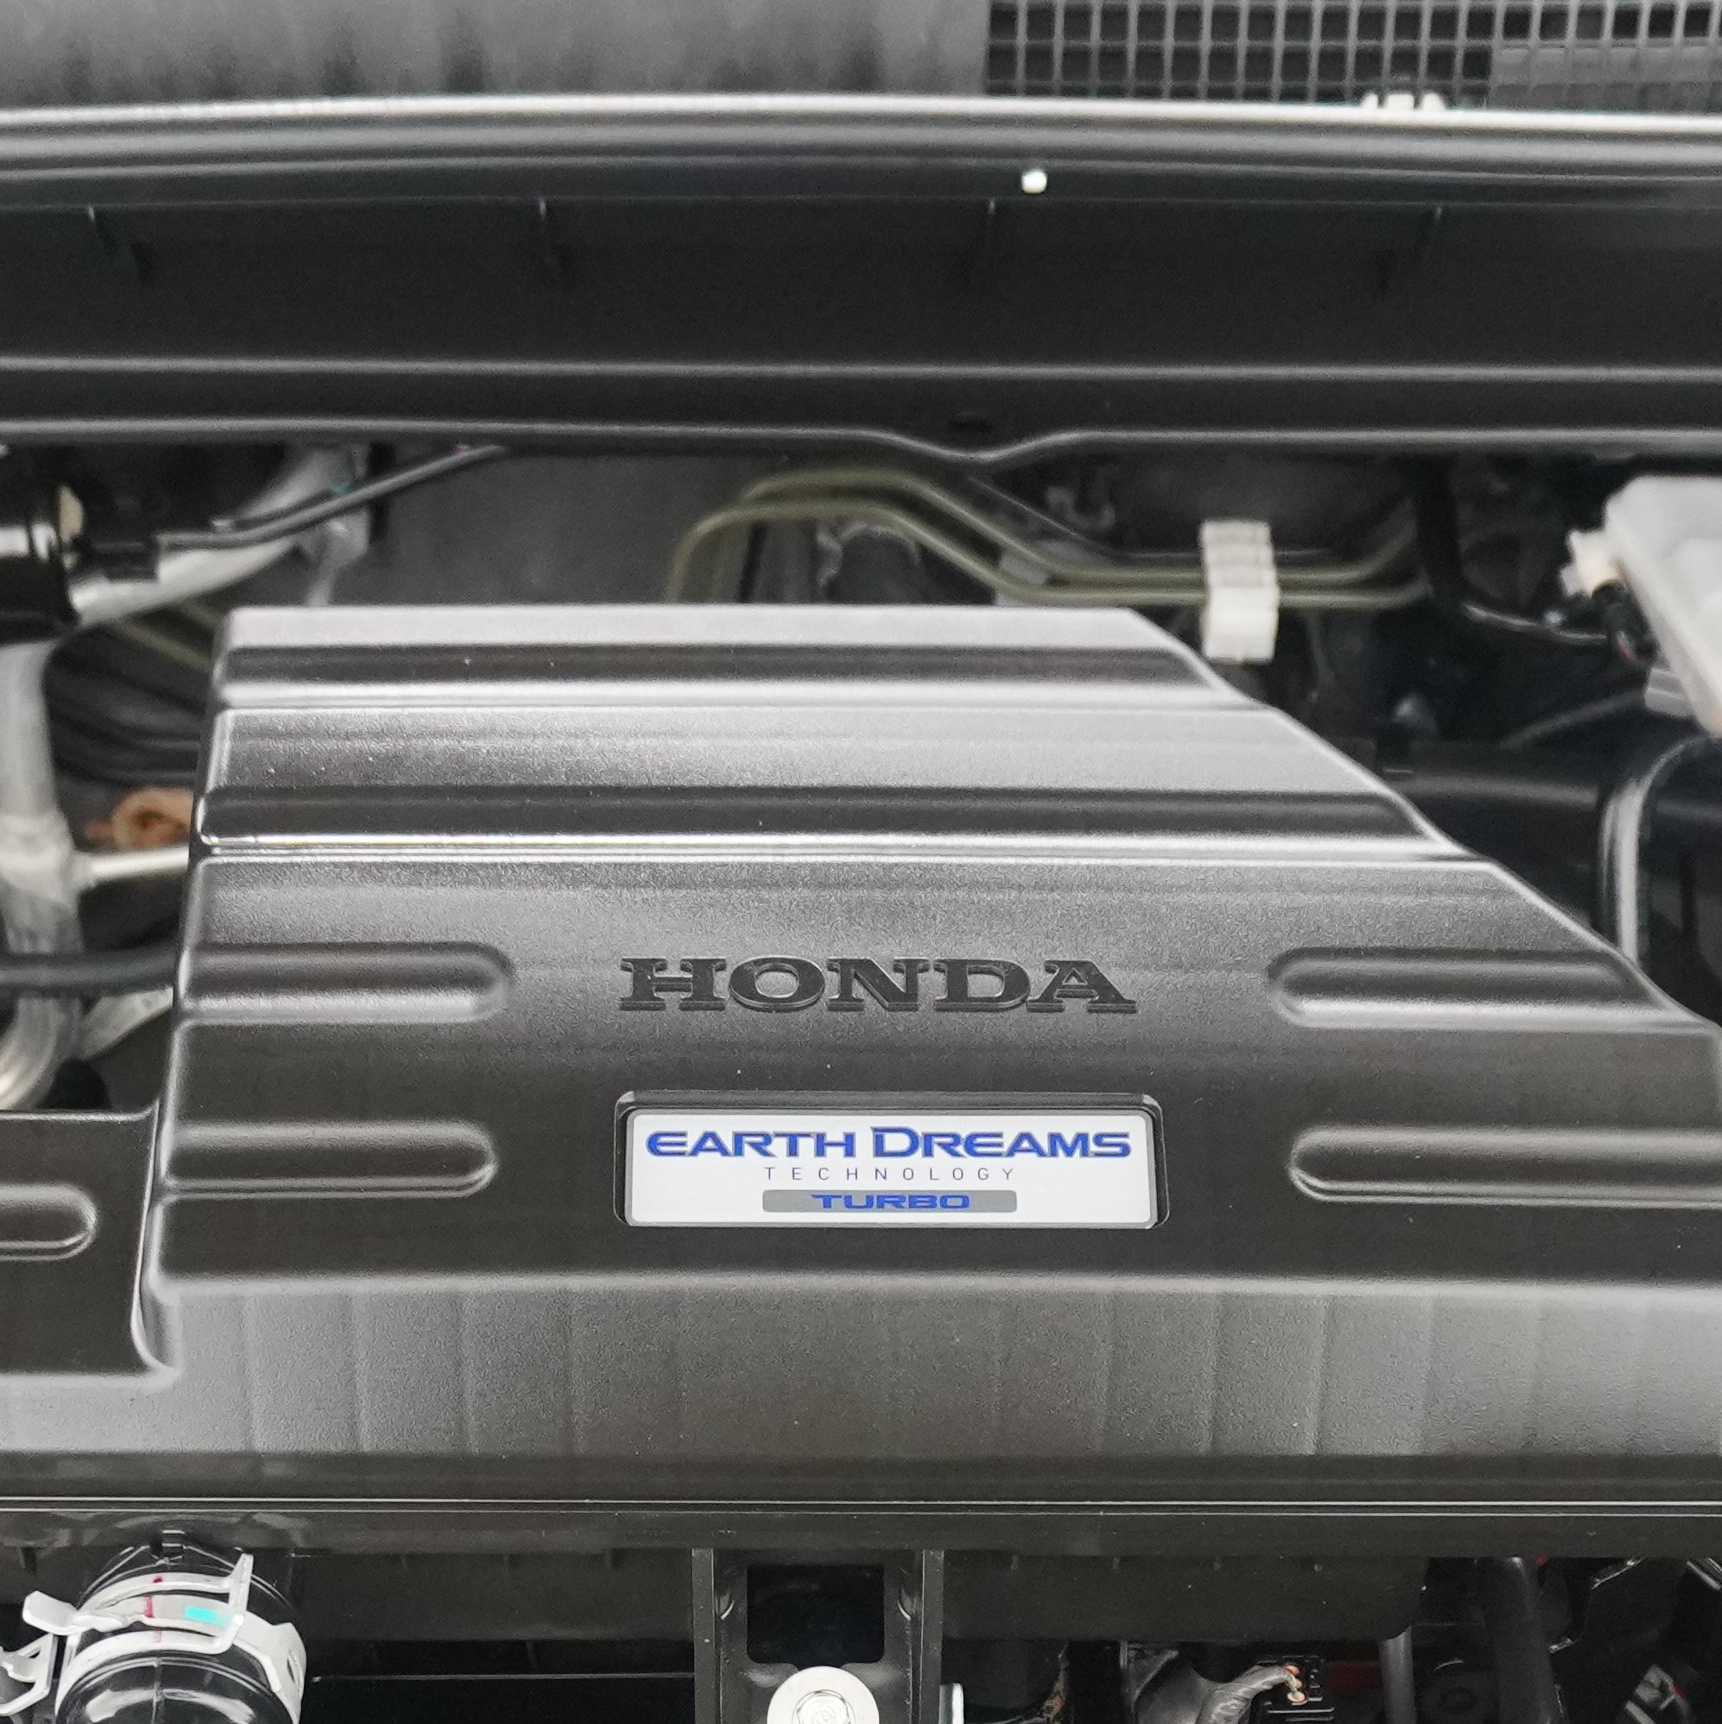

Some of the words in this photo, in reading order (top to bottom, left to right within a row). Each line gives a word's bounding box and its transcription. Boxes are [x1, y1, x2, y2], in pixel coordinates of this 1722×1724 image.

[618, 957, 1138, 1013] HONDA
[646, 1131, 856, 1160] EARTH
[872, 1125, 1132, 1160] DREAMS
[764, 1166, 1016, 1182] TECHNOLOGY
[810, 1192, 971, 1210] TURBO
